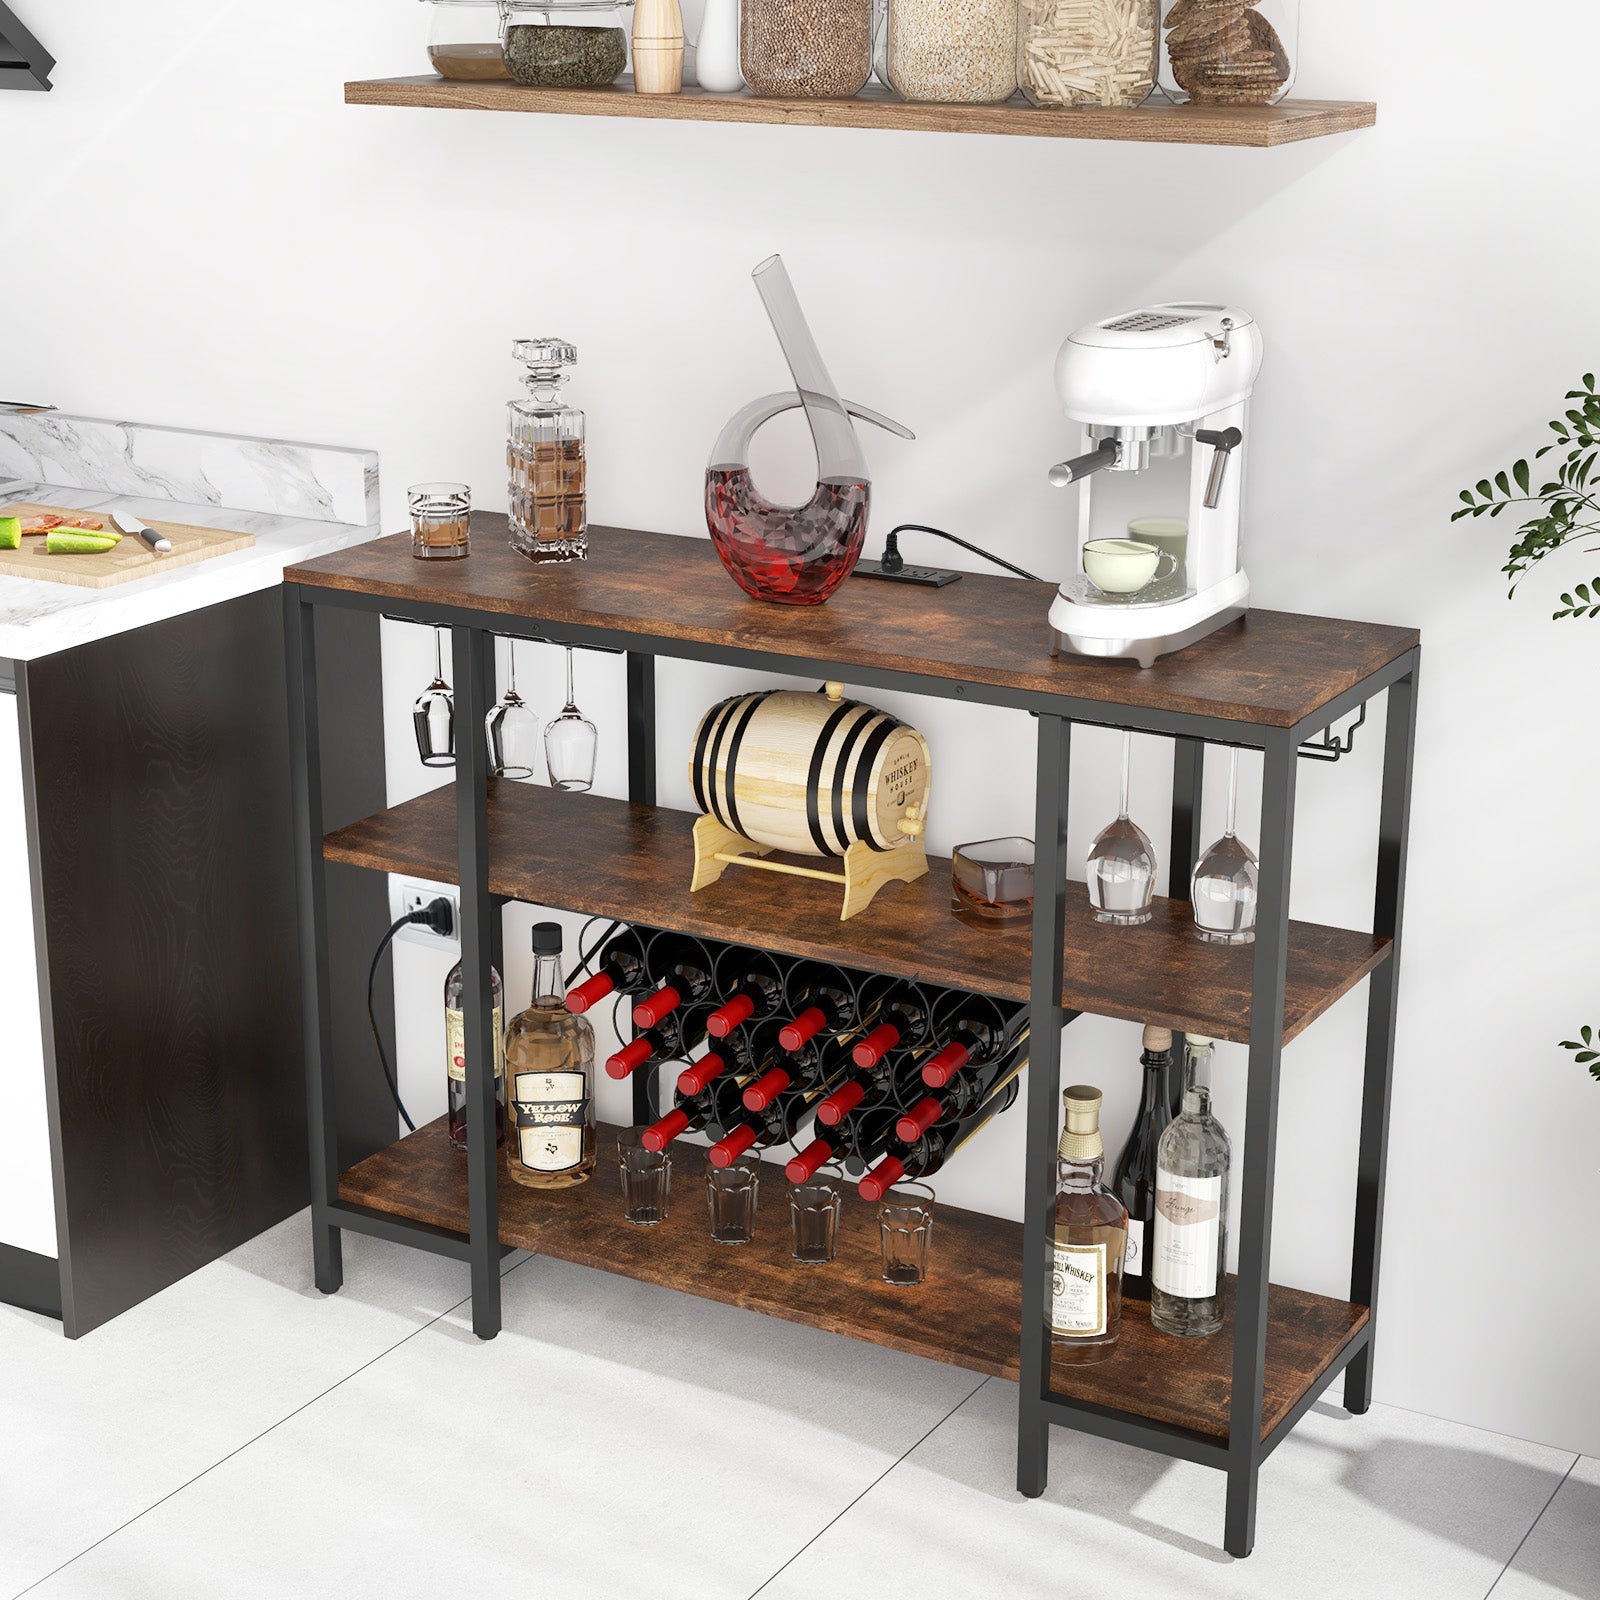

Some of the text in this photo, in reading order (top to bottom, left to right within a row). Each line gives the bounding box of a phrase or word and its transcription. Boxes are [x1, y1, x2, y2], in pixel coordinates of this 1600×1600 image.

[885, 758, 918, 784] WHISKEY
[890, 775, 913, 793] HOUSE
[518, 1103, 582, 1114] YELLOW
[533, 1113, 571, 1123] ROSE
[1065, 1262, 1095, 1283] WHISKEY
